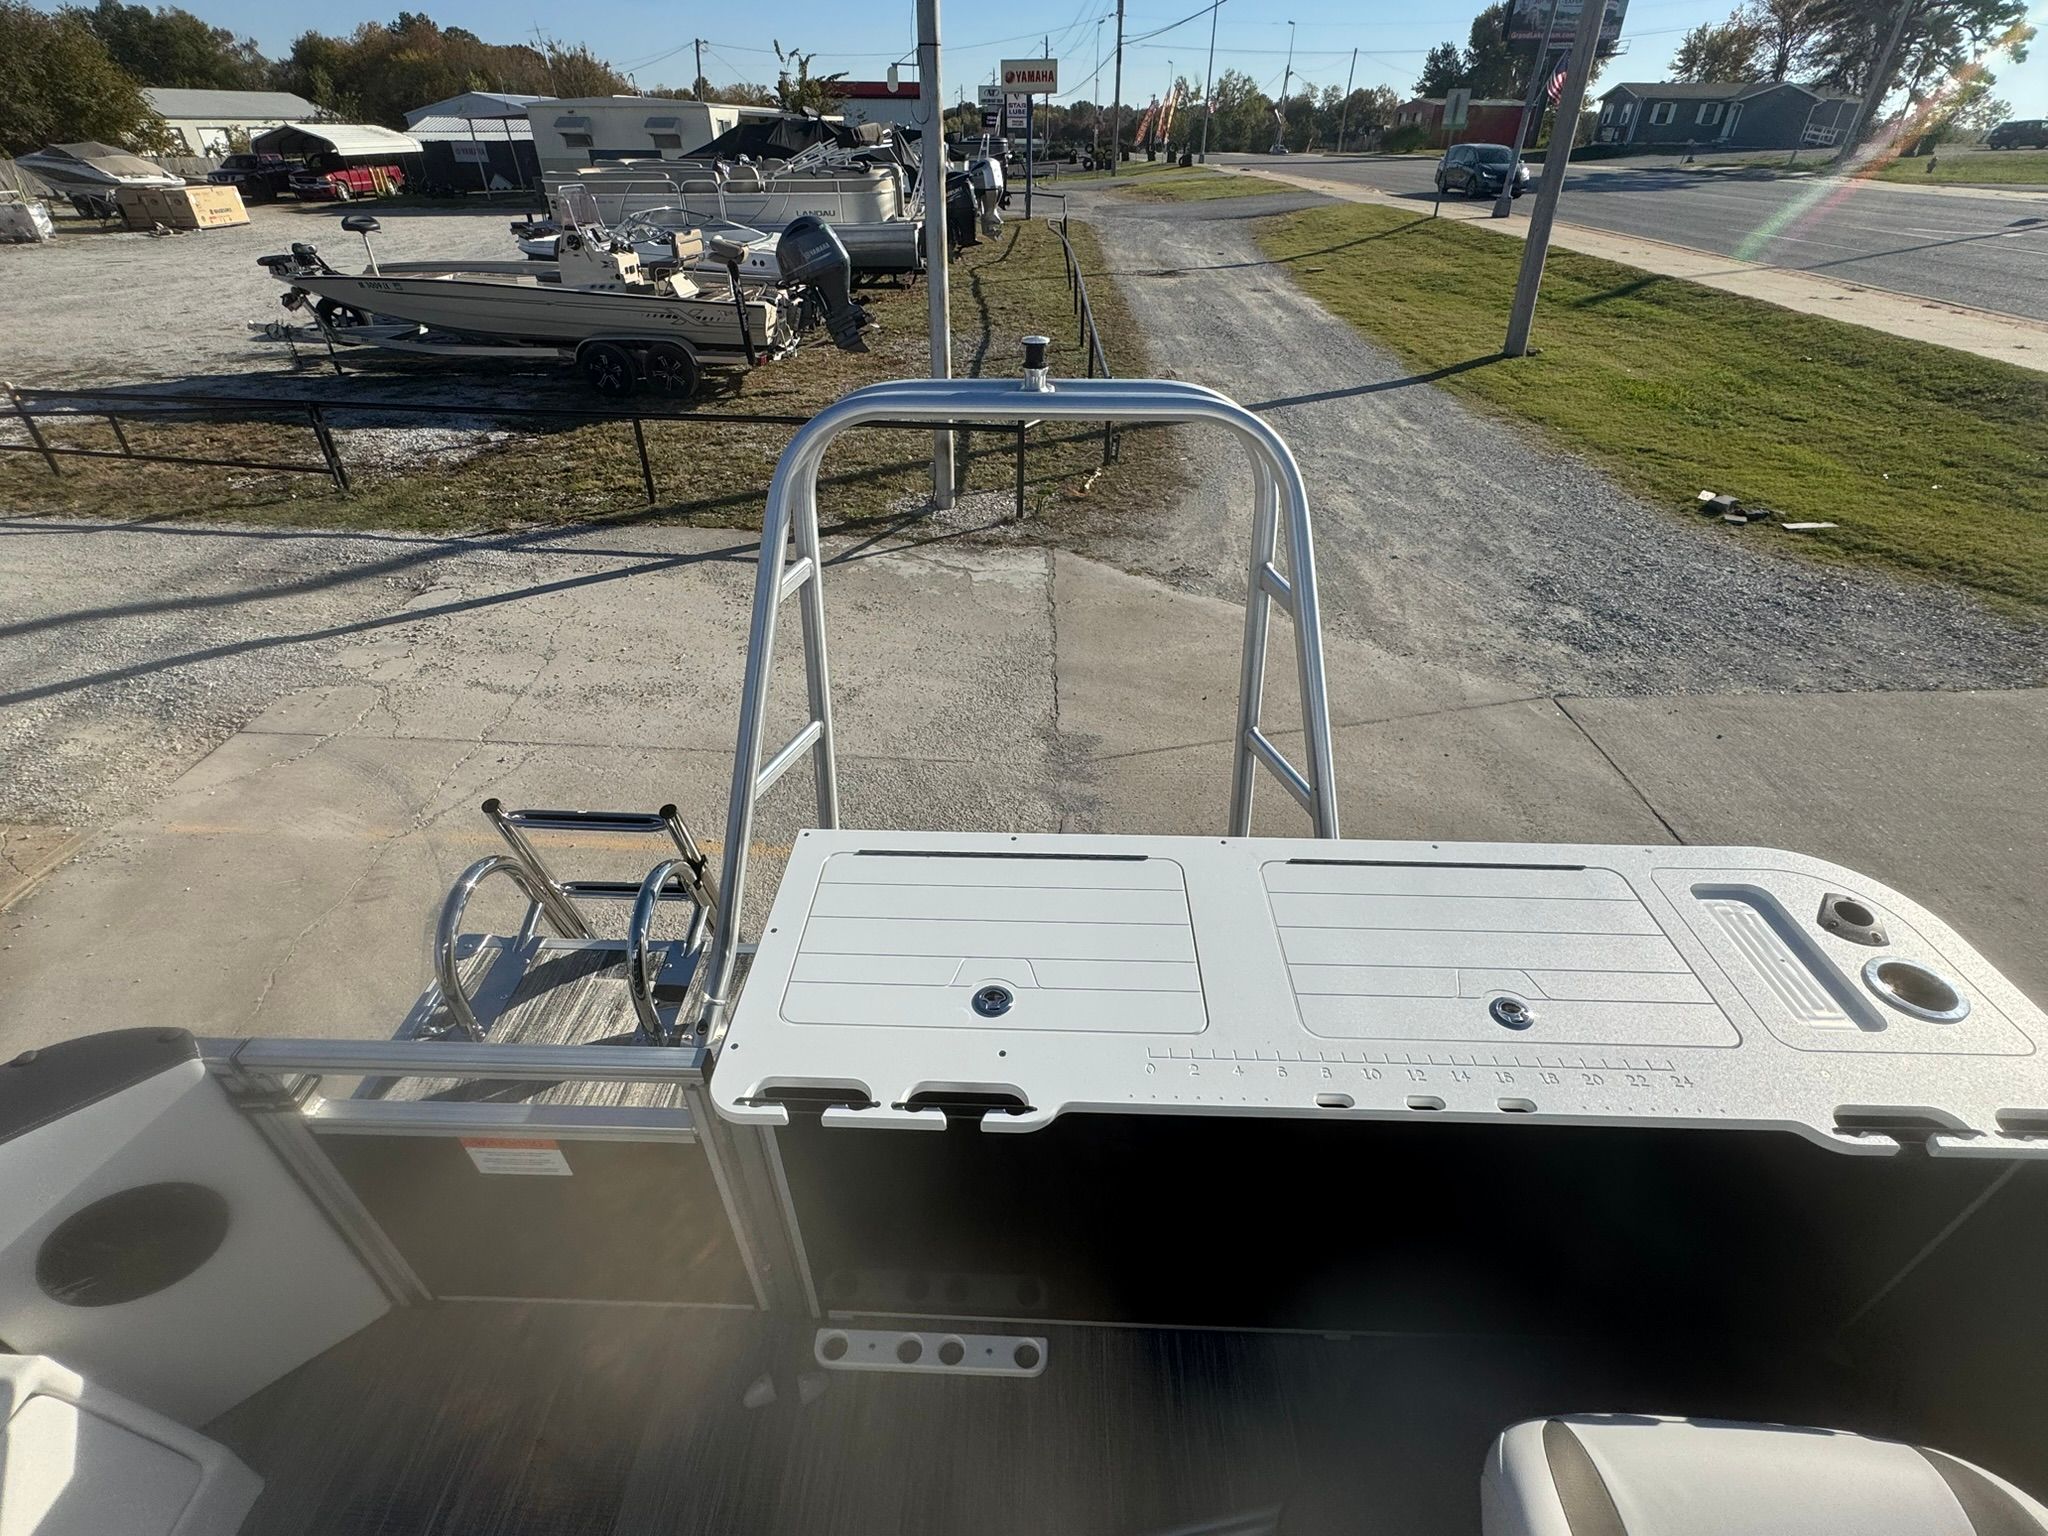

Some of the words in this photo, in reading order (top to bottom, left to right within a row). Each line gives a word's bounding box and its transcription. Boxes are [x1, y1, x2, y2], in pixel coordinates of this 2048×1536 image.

[1016, 70, 1054, 82] YAMAHA
[1144, 1063, 1156, 1075] 0
[1188, 1063, 1200, 1076] 2
[1232, 1065, 1244, 1077] 4
[1276, 1066, 1288, 1079] 6
[1320, 1067, 1333, 1079] 8
[1360, 1068, 1382, 1080] 10
[1407, 1069, 1428, 1082] 12
[1450, 1070, 1471, 1083] 14
[1495, 1071, 1515, 1084] 16
[1539, 1072, 1560, 1085] 18
[1581, 1073, 1605, 1086] 20
[1625, 1074, 1650, 1087] 22
[1670, 1076, 1694, 1088] 24
